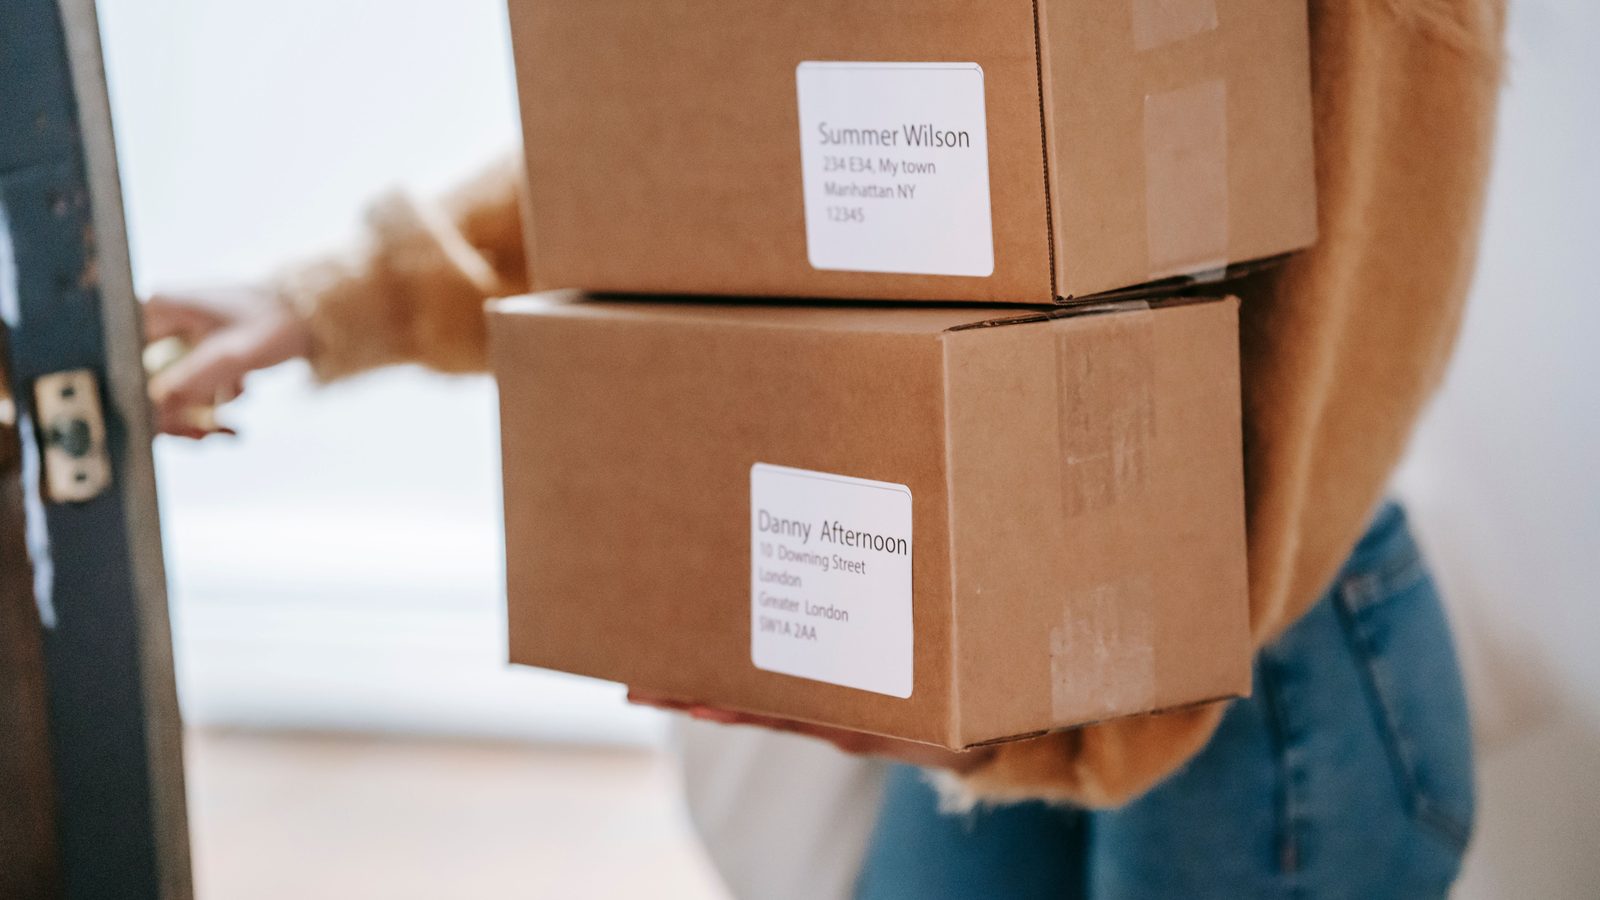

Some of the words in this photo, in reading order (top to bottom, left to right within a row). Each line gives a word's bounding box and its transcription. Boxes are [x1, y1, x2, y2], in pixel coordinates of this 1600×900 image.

[818, 122, 898, 146] Summer
[903, 123, 970, 148] Wilson
[823, 156, 846, 172] 234
[879, 158, 898, 177] My
[902, 160, 936, 174] town
[824, 182, 894, 198] Manhattan
[898, 184, 916, 199] NY
[826, 207, 865, 222] 12345
[758, 509, 812, 544] Danny
[820, 520, 907, 556] Afternoon
[760, 542, 773, 558] 10
[778, 545, 829, 572] Downing
[832, 554, 866, 575] Street
[759, 567, 802, 587] London
[759, 591, 800, 612] Greater
[805, 600, 849, 622] London
[759, 615, 791, 635] SW1A
[794, 623, 818, 641] 2AA
